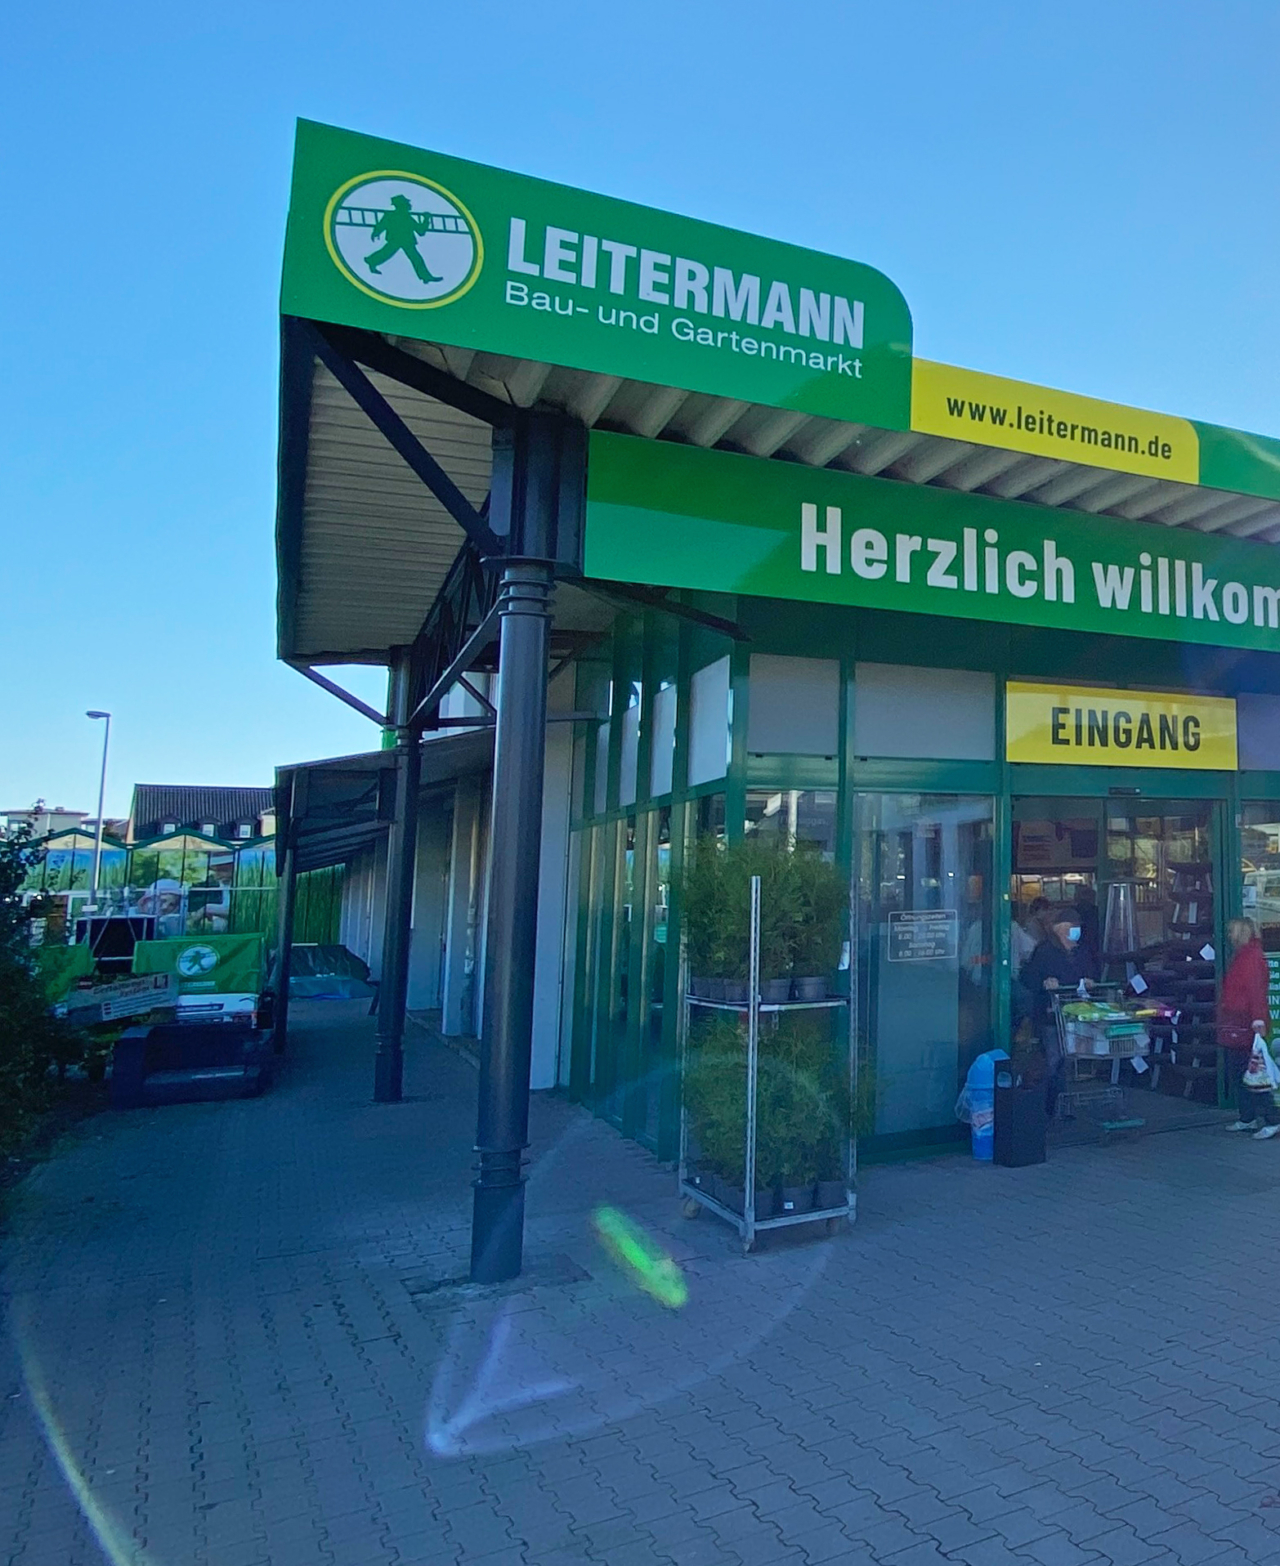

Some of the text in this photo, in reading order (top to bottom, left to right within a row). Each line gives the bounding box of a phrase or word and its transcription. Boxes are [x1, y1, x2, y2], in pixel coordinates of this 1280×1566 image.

[505, 281, 863, 378] Bau- und Gartenmarkt
[507, 217, 864, 349] LEITERMANN
[946, 397, 1173, 460] www.leitermann.de
[800, 502, 1075, 605] Herzlich
[1051, 708, 1202, 753] EINGANG
